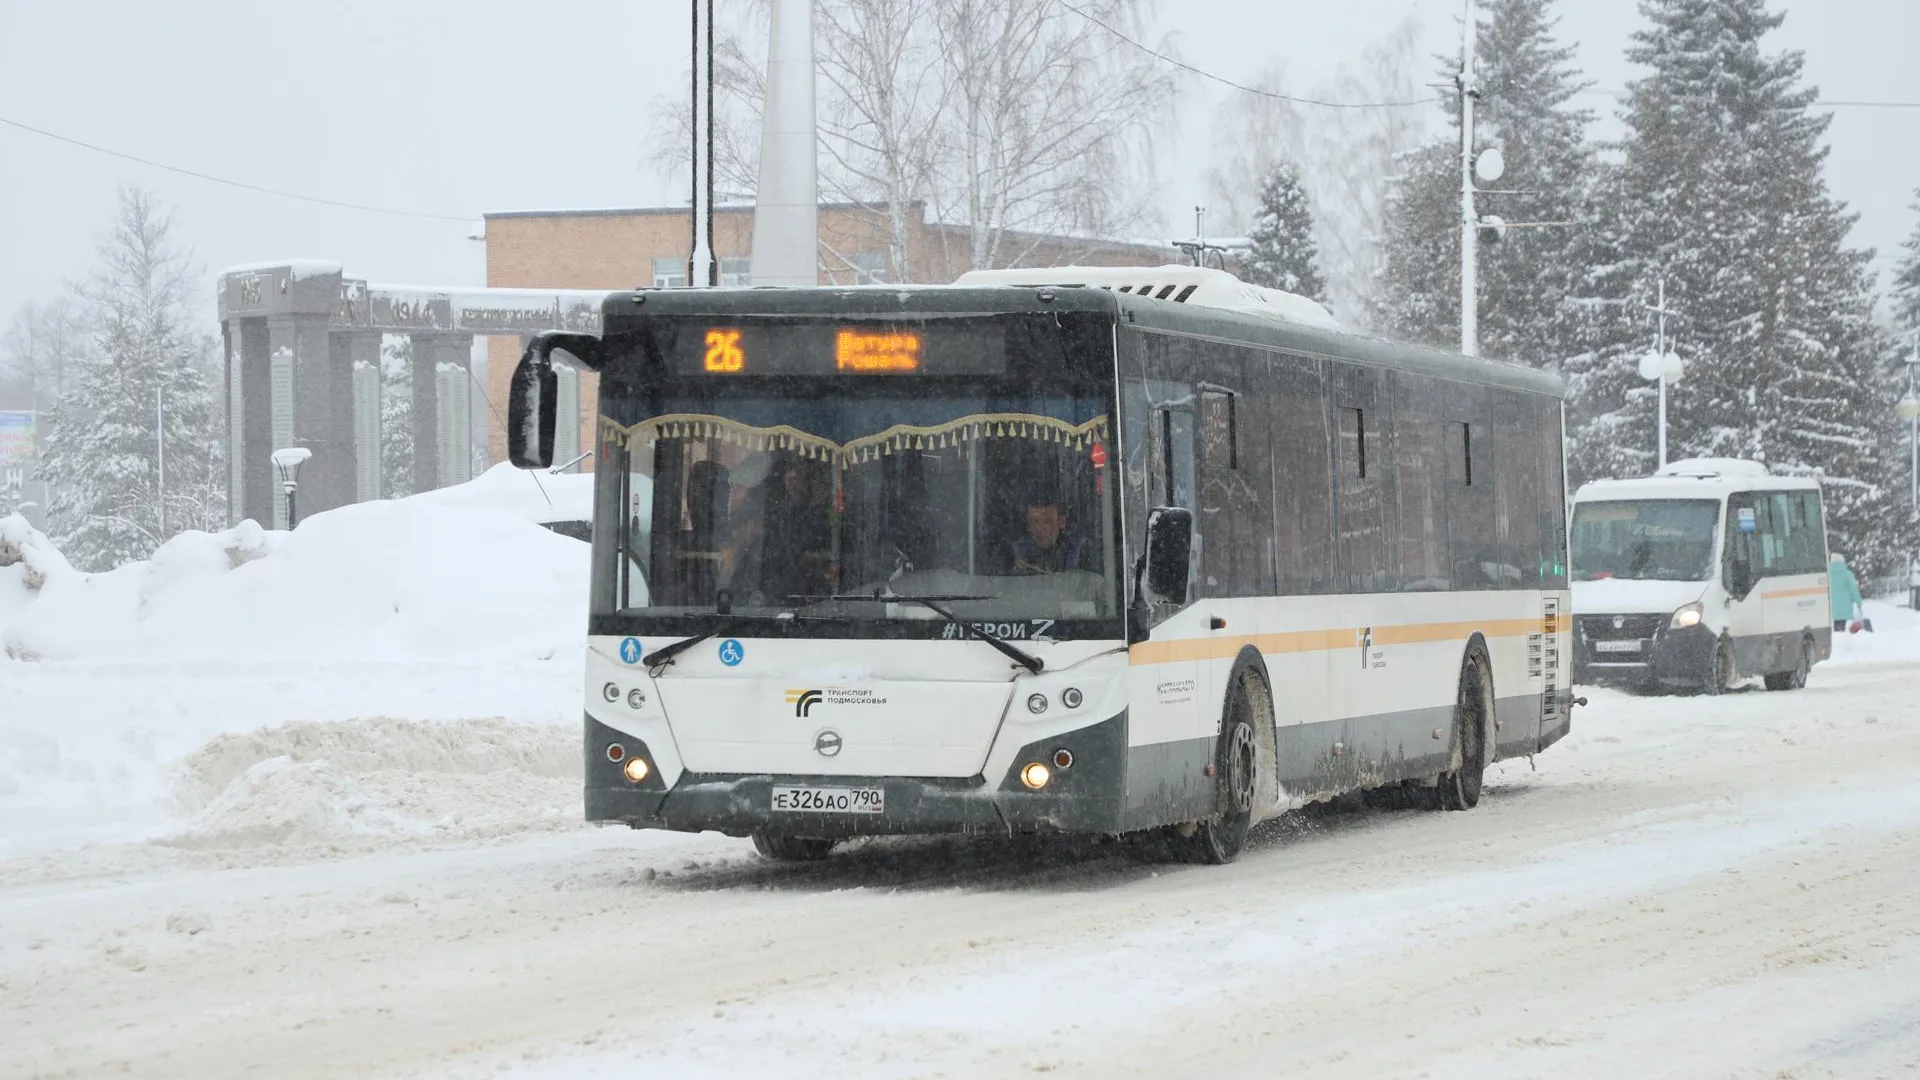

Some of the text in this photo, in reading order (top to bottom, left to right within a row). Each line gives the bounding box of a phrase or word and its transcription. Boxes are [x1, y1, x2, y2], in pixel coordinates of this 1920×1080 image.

[705, 329, 743, 372] 26
[827, 697, 887, 705] ПОДМОСКОВЬЯ
[852, 790, 879, 805] 790
